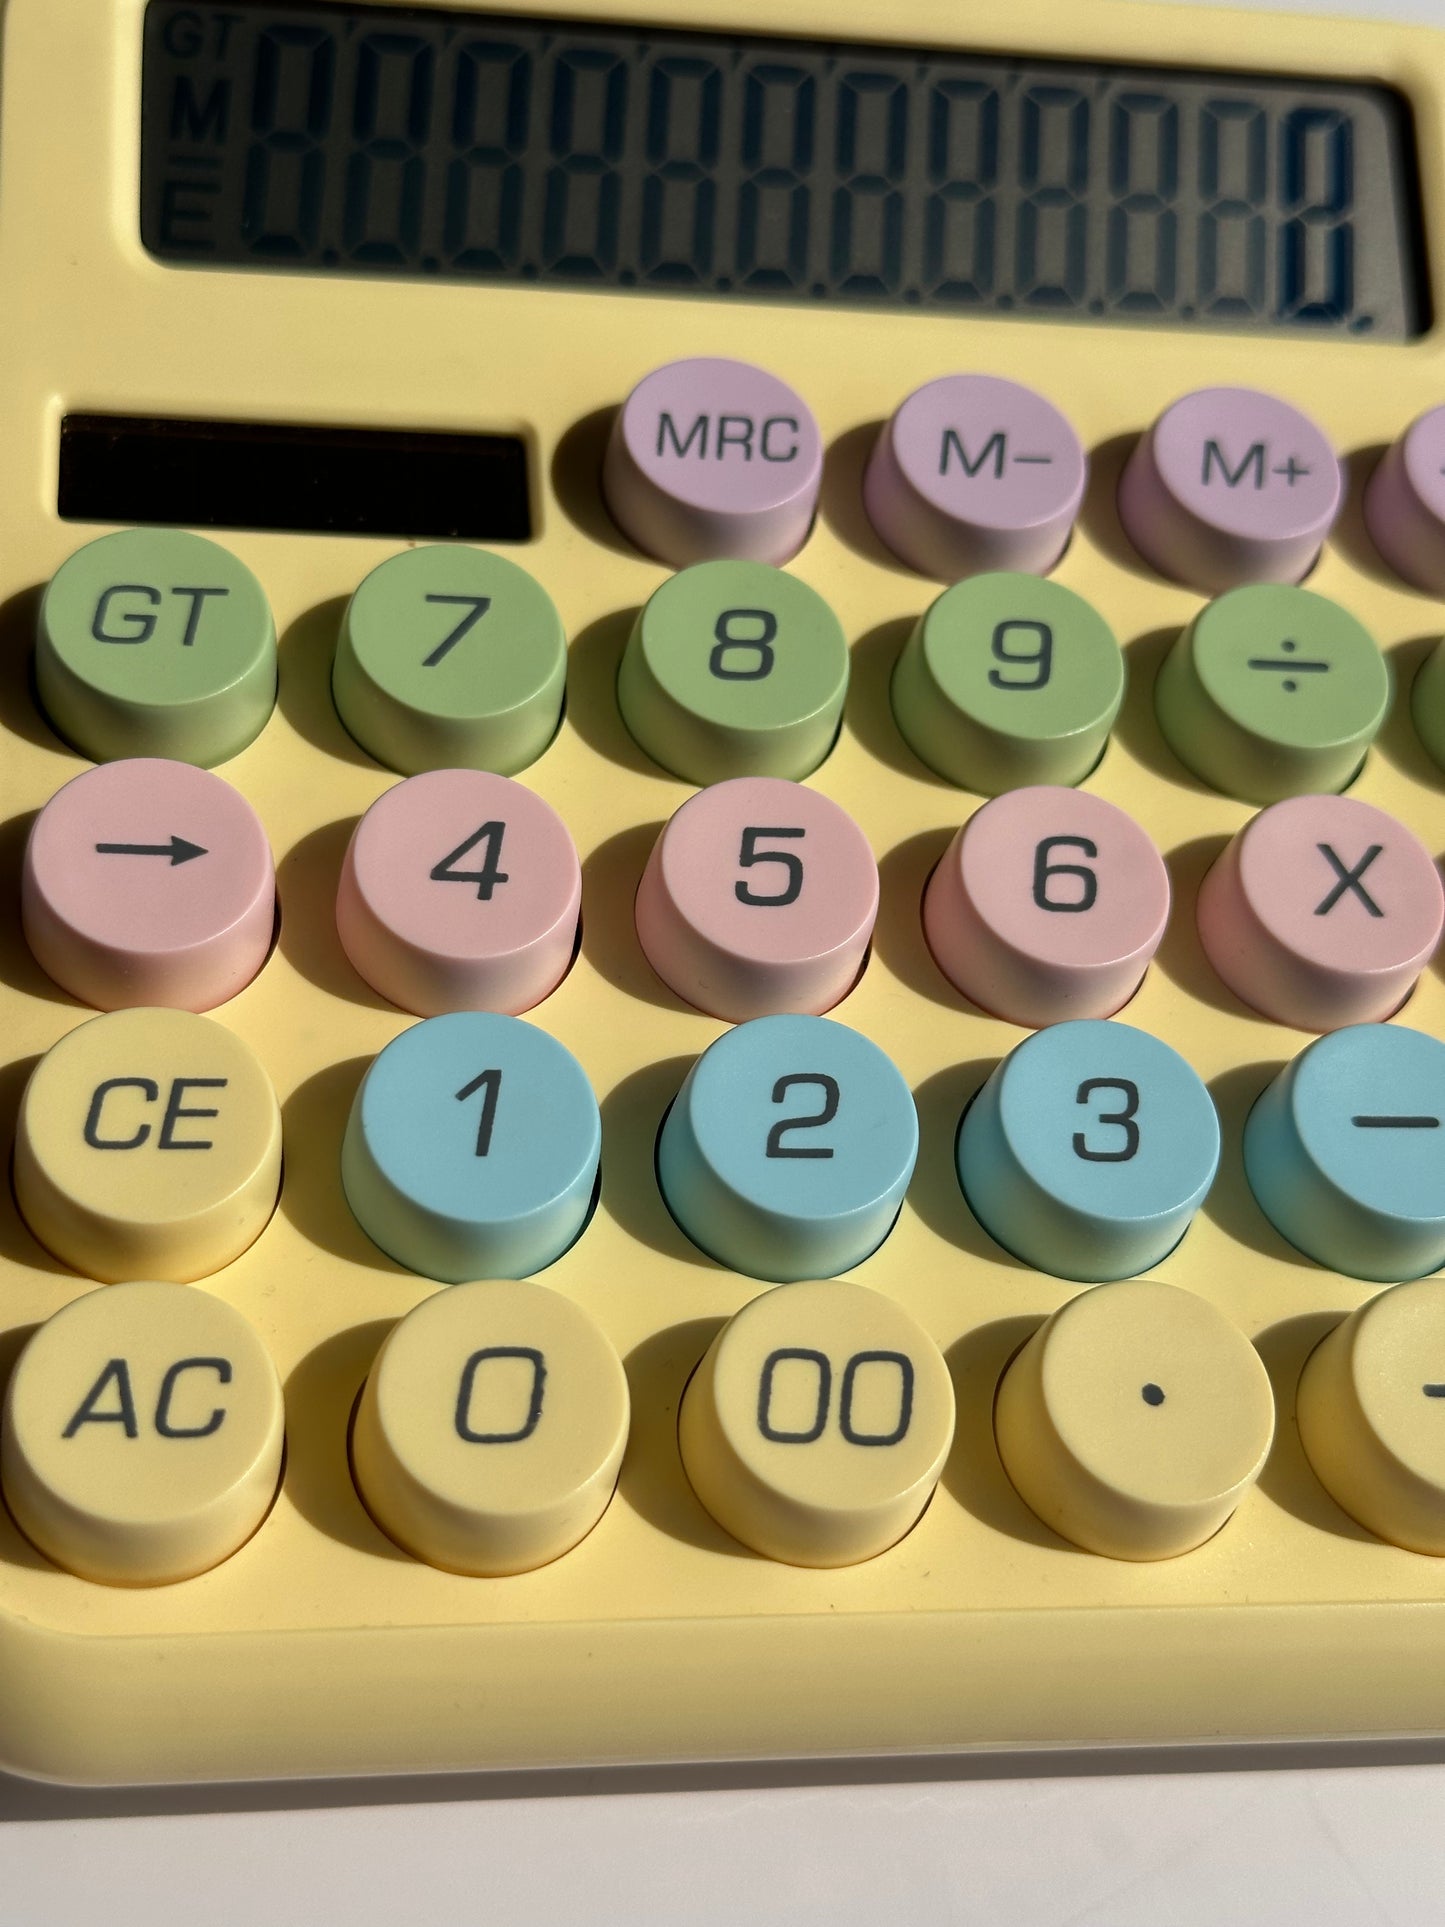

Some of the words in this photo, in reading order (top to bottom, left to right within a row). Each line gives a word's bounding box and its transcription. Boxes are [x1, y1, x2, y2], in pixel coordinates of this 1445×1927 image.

[655, 412, 799, 463] MRC
[939, 428, 1052, 479] M-
[1201, 439, 1310, 490] M+
[90, 584, 230, 647] GT
[421, 593, 492, 667] 7
[708, 608, 778, 682] 8
[988, 619, 1054, 691] 9
[429, 820, 509, 901] 4
[734, 826, 806, 907] 5
[1032, 835, 1098, 914] 6
[82, 1077, 228, 1151] CE
[454, 1069, 503, 1158] 1
[765, 1072, 841, 1159] 2
[1072, 1077, 1140, 1163] 3
[61, 1357, 233, 1440] AC
[454, 1346, 548, 1445] 0
[756, 1347, 915, 1448] 00
